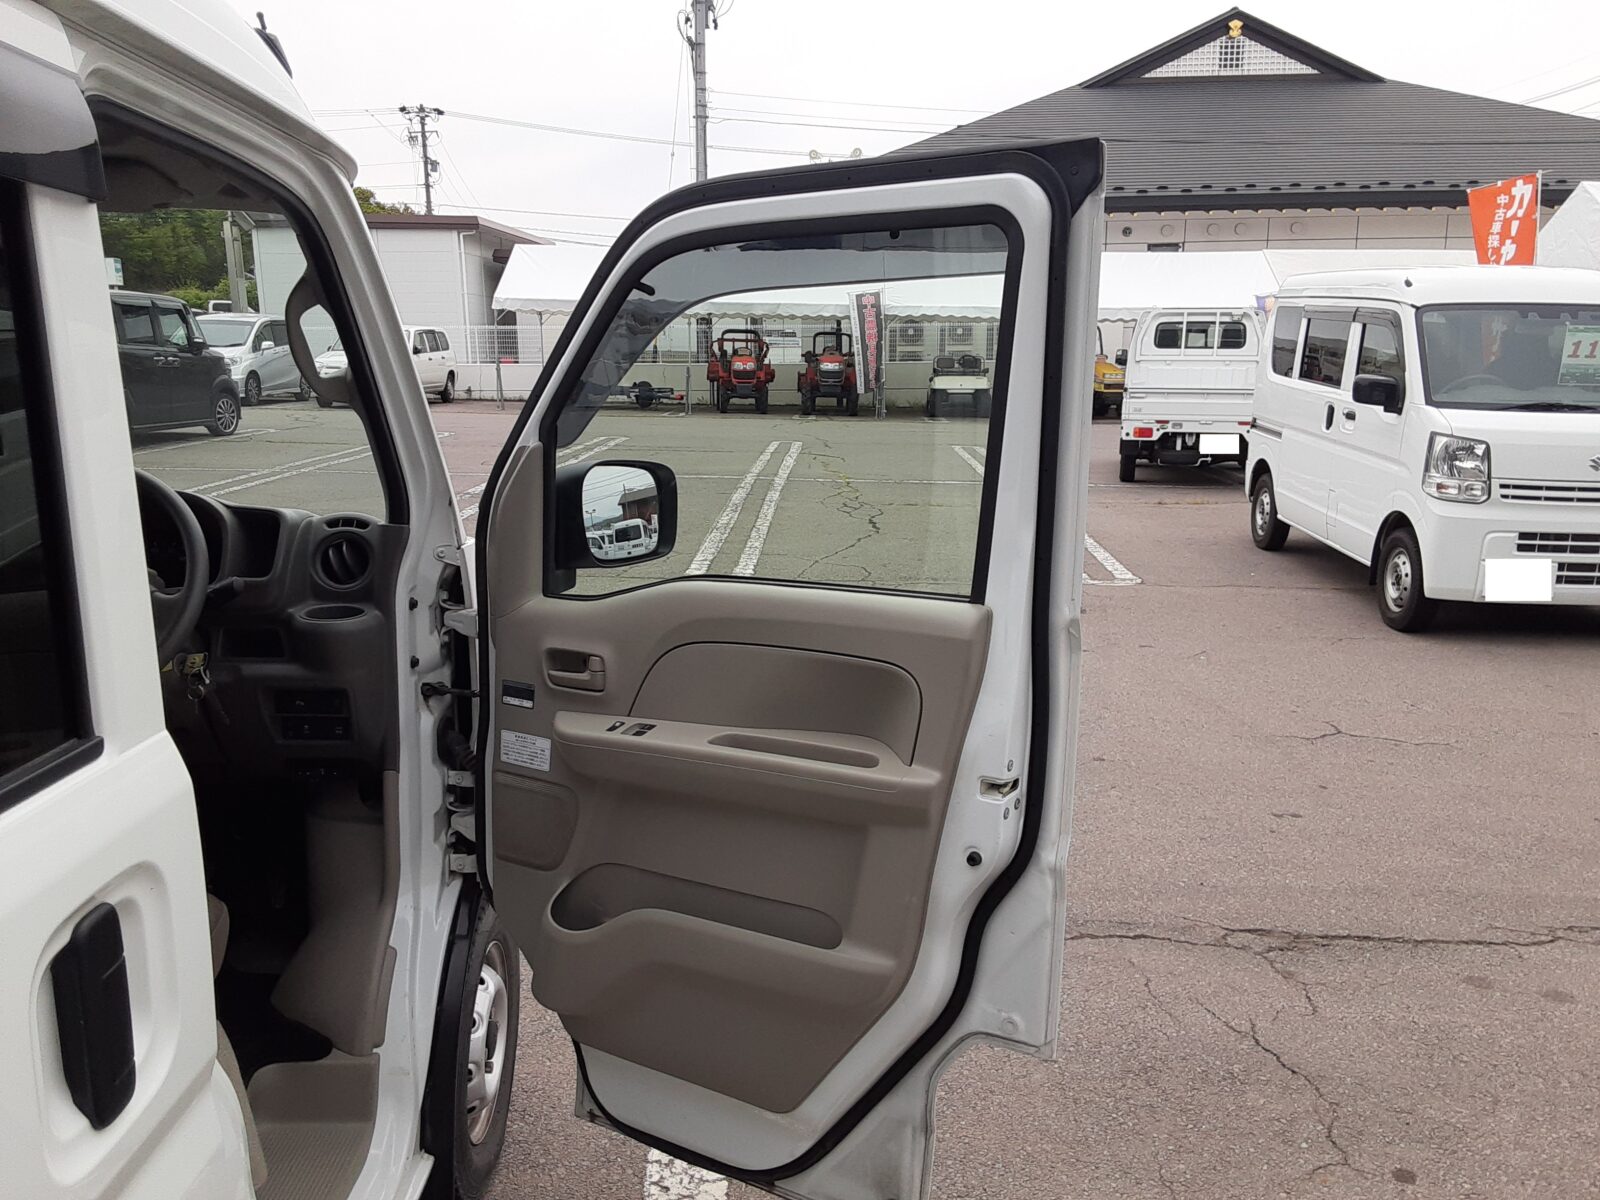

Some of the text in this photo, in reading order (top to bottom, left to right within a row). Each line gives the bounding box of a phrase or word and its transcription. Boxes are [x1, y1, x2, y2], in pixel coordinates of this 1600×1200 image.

[1487, 193, 1510, 265] 中古車探し
[1567, 340, 1599, 358] 11
